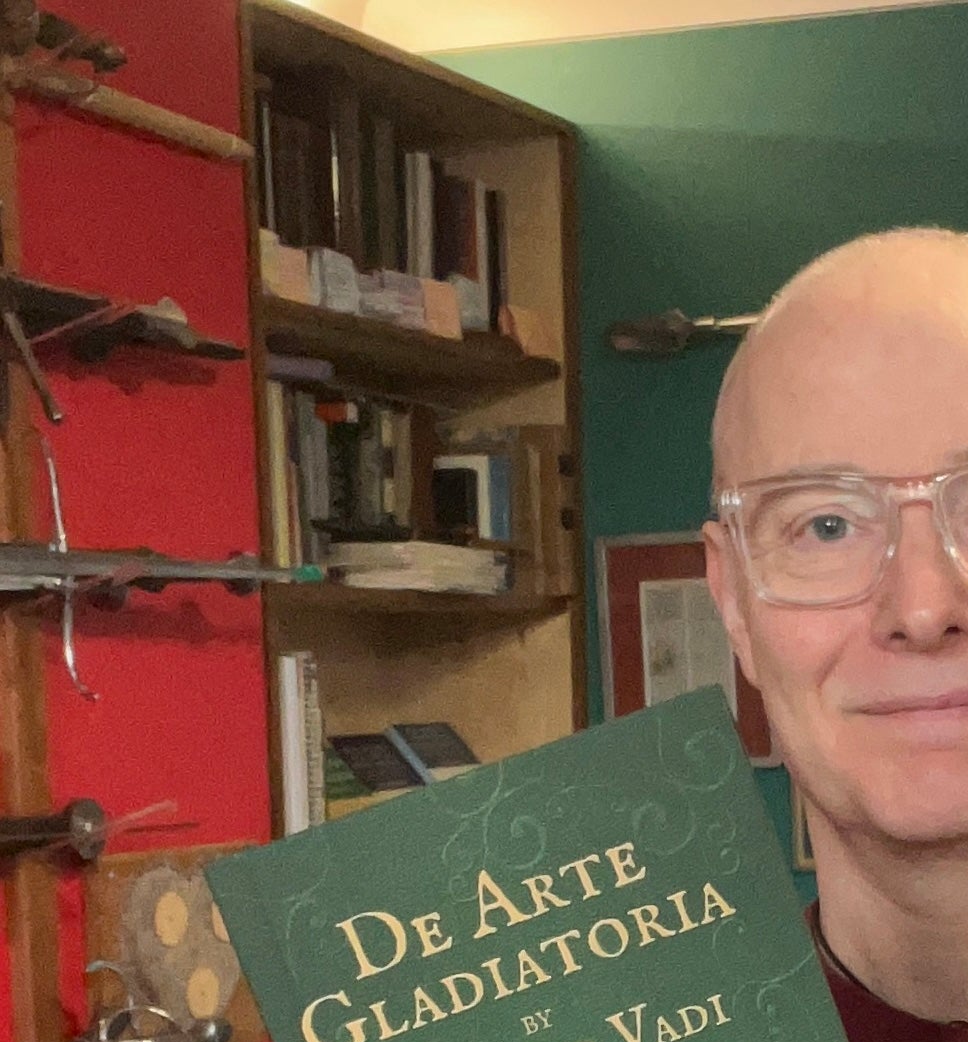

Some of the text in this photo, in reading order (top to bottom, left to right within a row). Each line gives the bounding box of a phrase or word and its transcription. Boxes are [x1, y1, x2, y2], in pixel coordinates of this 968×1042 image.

[336, 842, 646, 980] DE ARTE
[521, 1009, 553, 1035] BY
